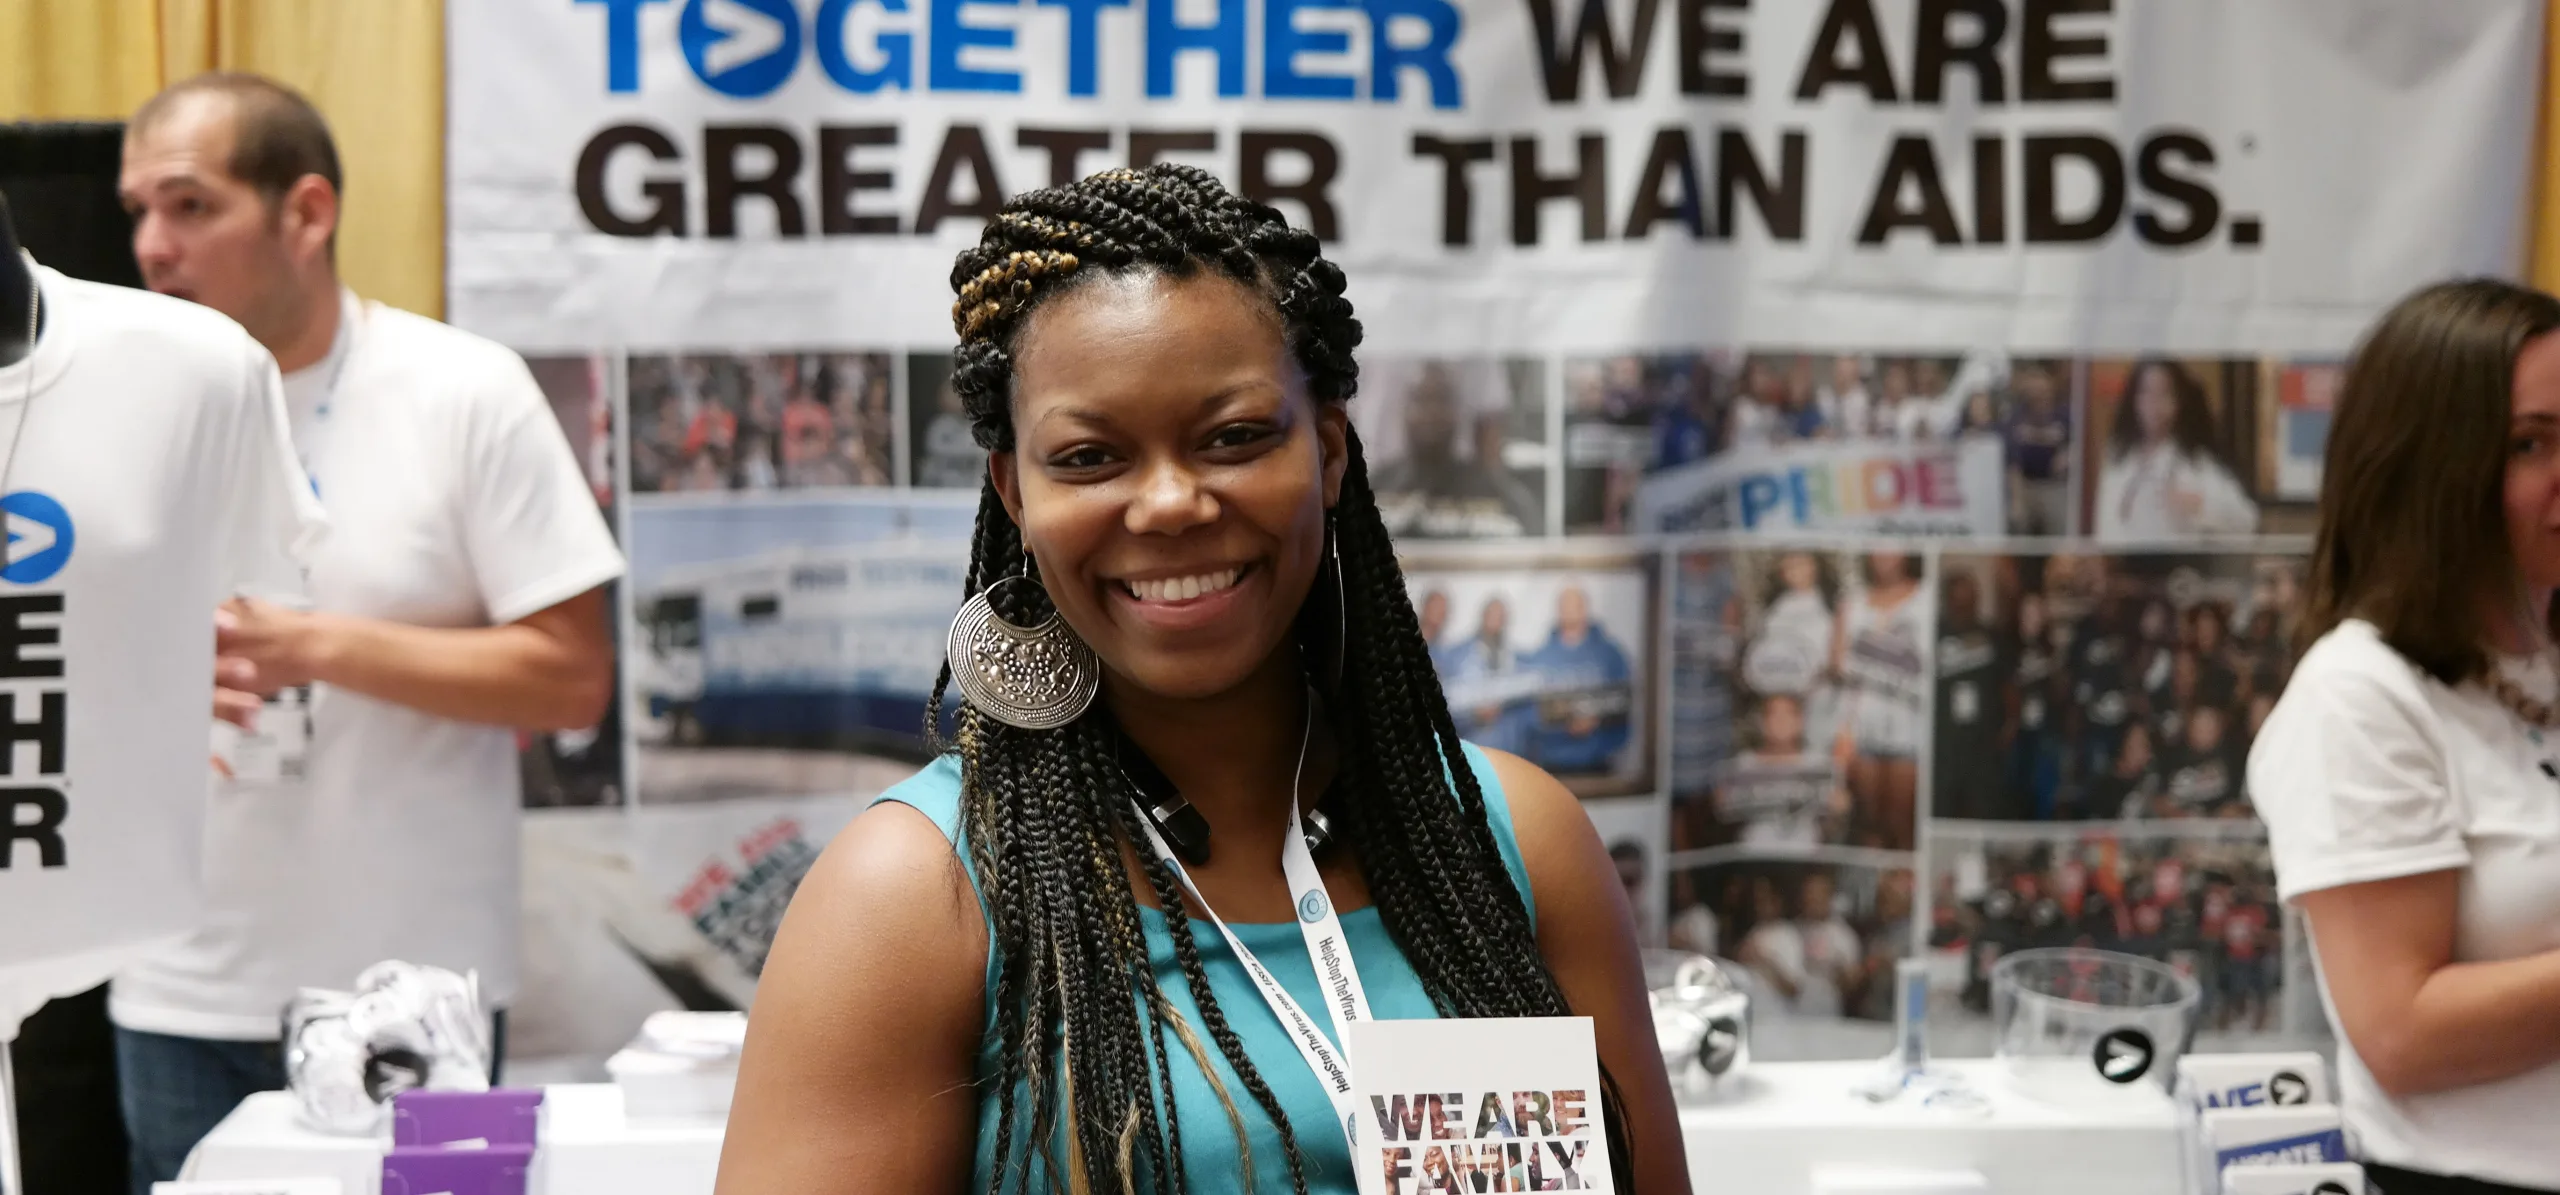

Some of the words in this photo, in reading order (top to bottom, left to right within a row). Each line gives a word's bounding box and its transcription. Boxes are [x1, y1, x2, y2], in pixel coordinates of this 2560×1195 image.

[1526, 0, 1752, 104] WE
[1794, 0, 2118, 105] ARE
[1411, 126, 1807, 246] THAN
[1855, 124, 2264, 250] AIDS.
[1739, 457, 1965, 532] PRIDE
[1319, 936, 1357, 1022] HelpStopTheVirus
[1370, 1092, 1467, 1142] WE
[1474, 1089, 1591, 1139] ARE
[2225, 1141, 2324, 1167] DATE
